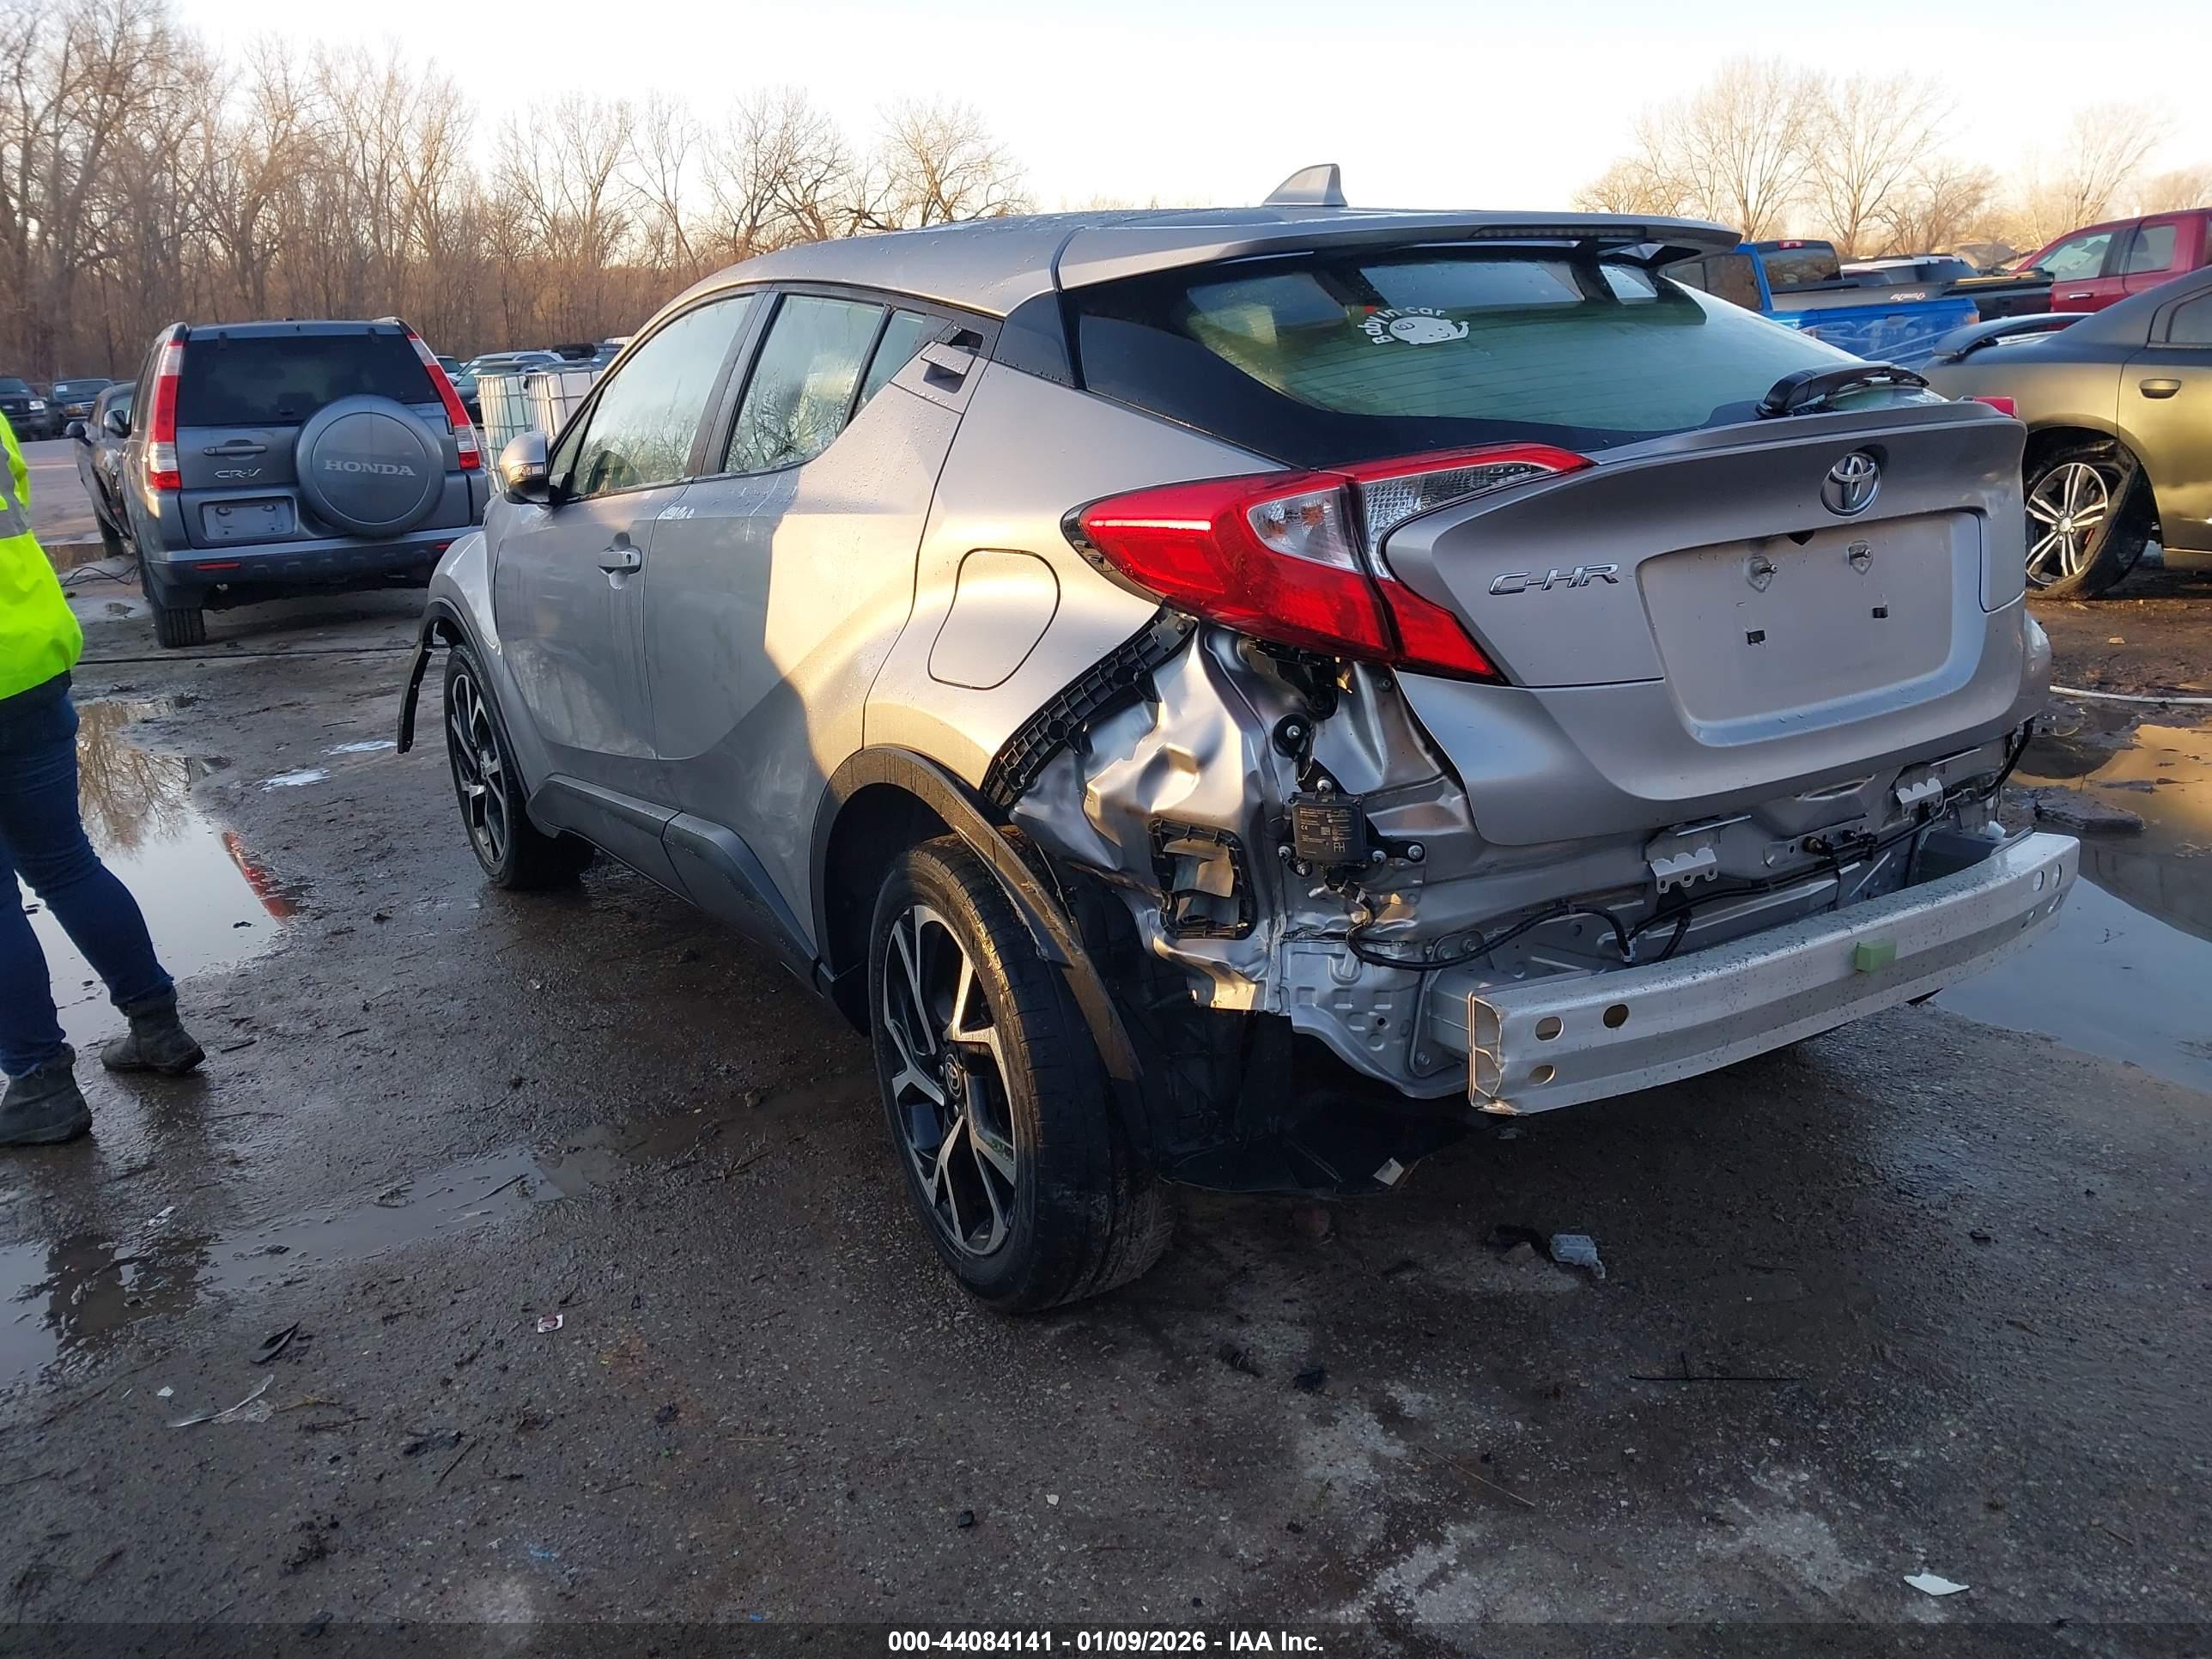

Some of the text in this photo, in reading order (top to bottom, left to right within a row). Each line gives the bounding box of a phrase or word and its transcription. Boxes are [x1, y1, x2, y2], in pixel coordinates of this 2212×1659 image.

[1357, 315, 1395, 344] Baby
[1405, 306, 1446, 317] car
[215, 468, 262, 479] CR-V
[325, 459, 416, 477] HONDA
[1488, 562, 1620, 596] C-HR
